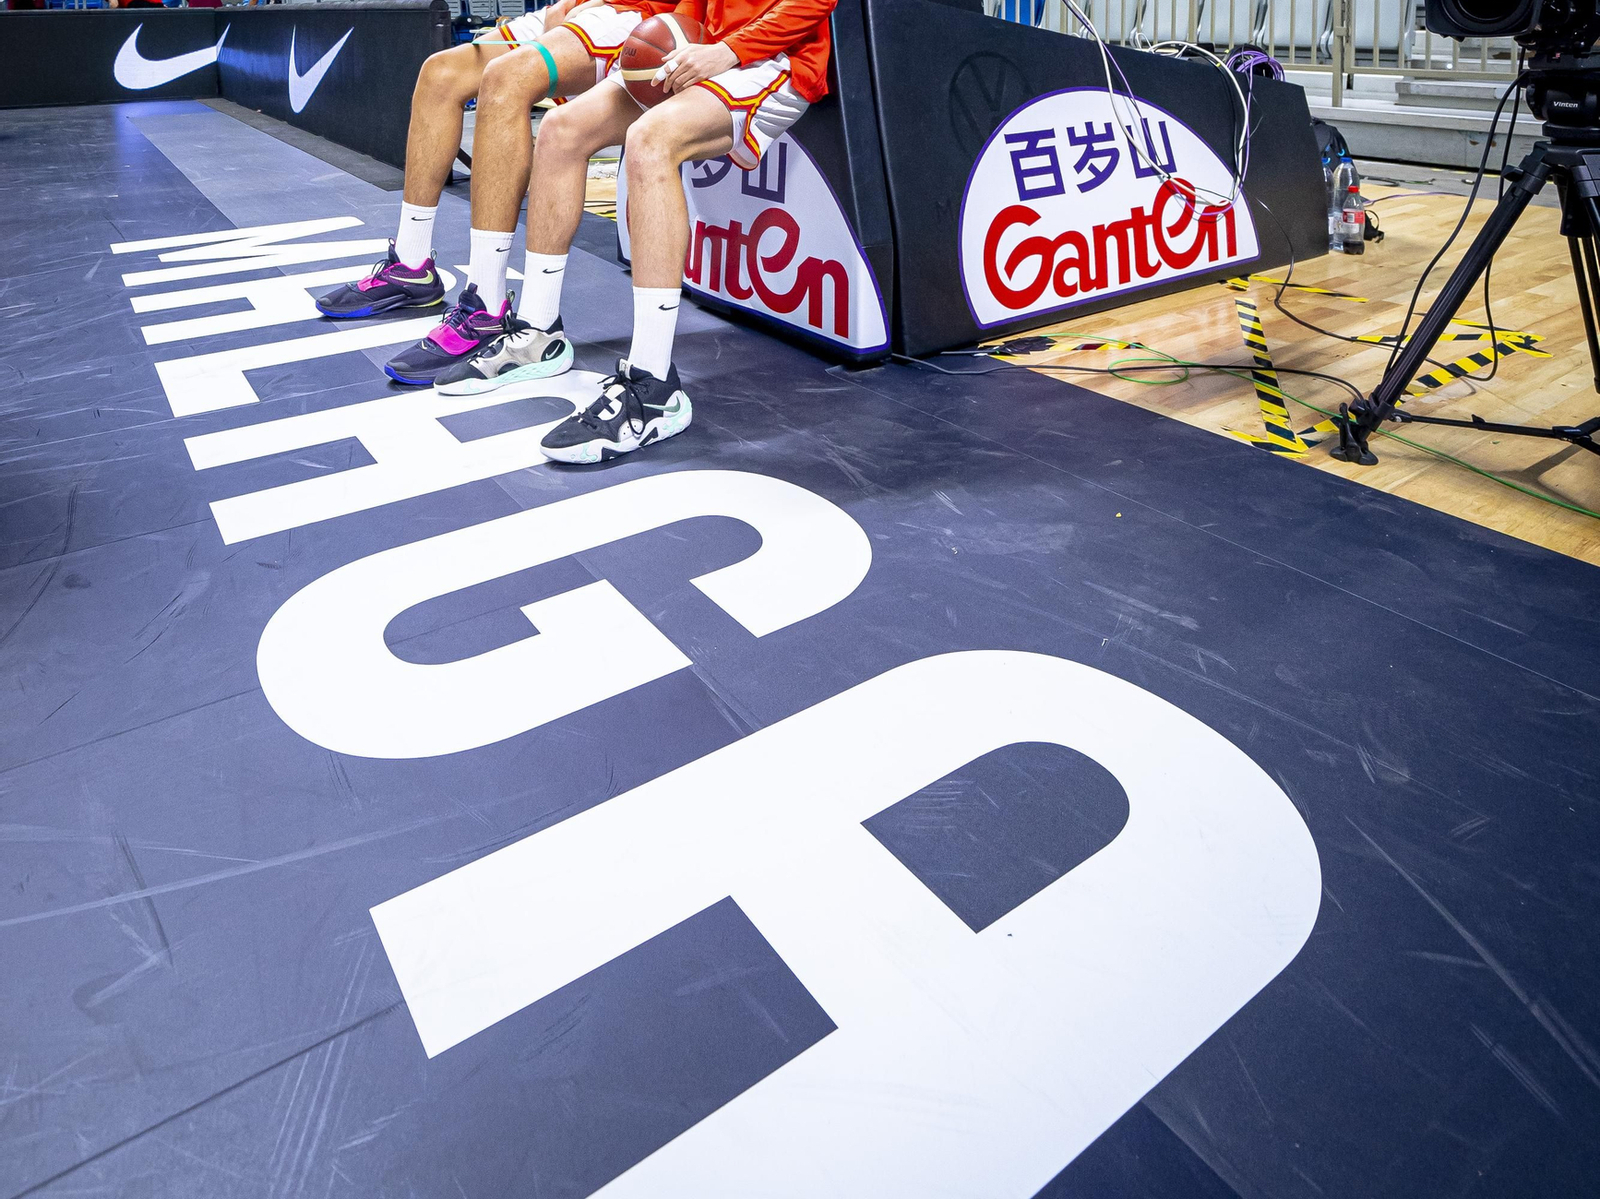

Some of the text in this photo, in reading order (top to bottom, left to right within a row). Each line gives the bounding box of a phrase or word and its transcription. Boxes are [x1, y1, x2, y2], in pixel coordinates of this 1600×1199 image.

[1004, 117, 1177, 201] 百岁山
[684, 207, 849, 339] nten
[983, 177, 1237, 310] Ganten
